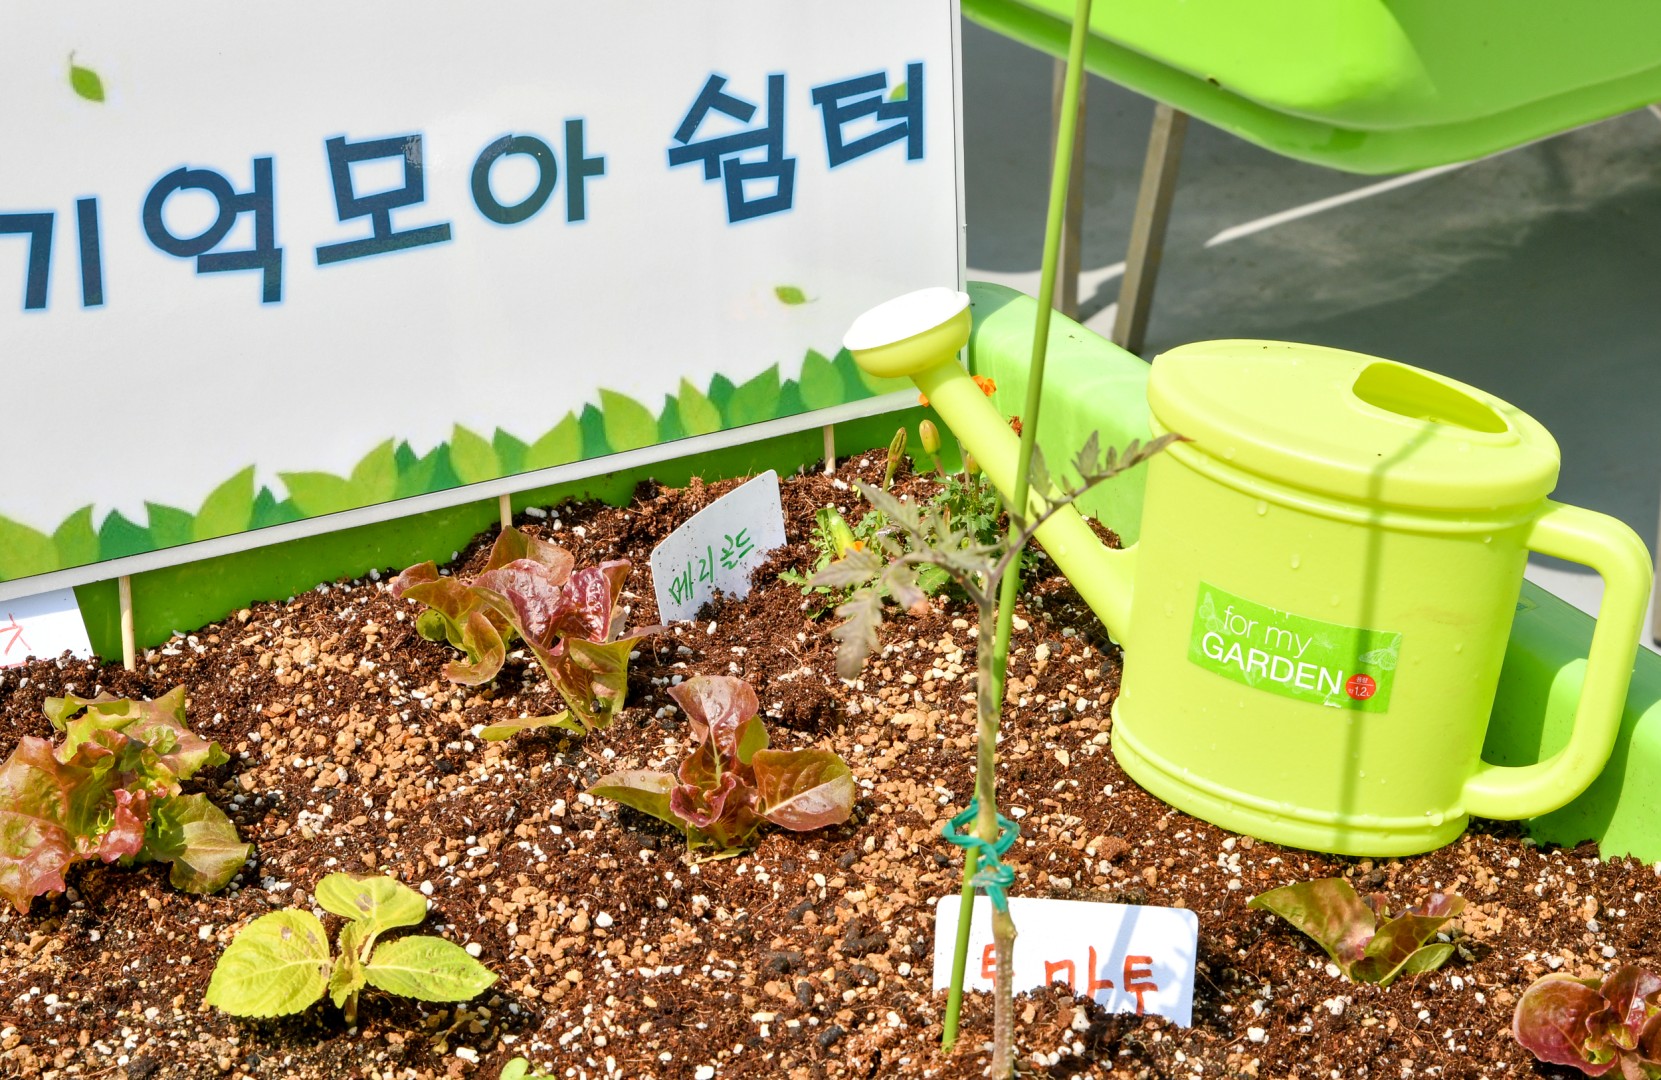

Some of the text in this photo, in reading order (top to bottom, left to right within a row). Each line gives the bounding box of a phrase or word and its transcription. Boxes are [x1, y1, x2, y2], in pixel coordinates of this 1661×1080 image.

[0, 62, 925, 310] 기억모아 쉼터
[668, 527, 755, 605] 메리골드
[1201, 631, 1343, 695] GARDEN
[1224, 605, 1312, 659] for my
